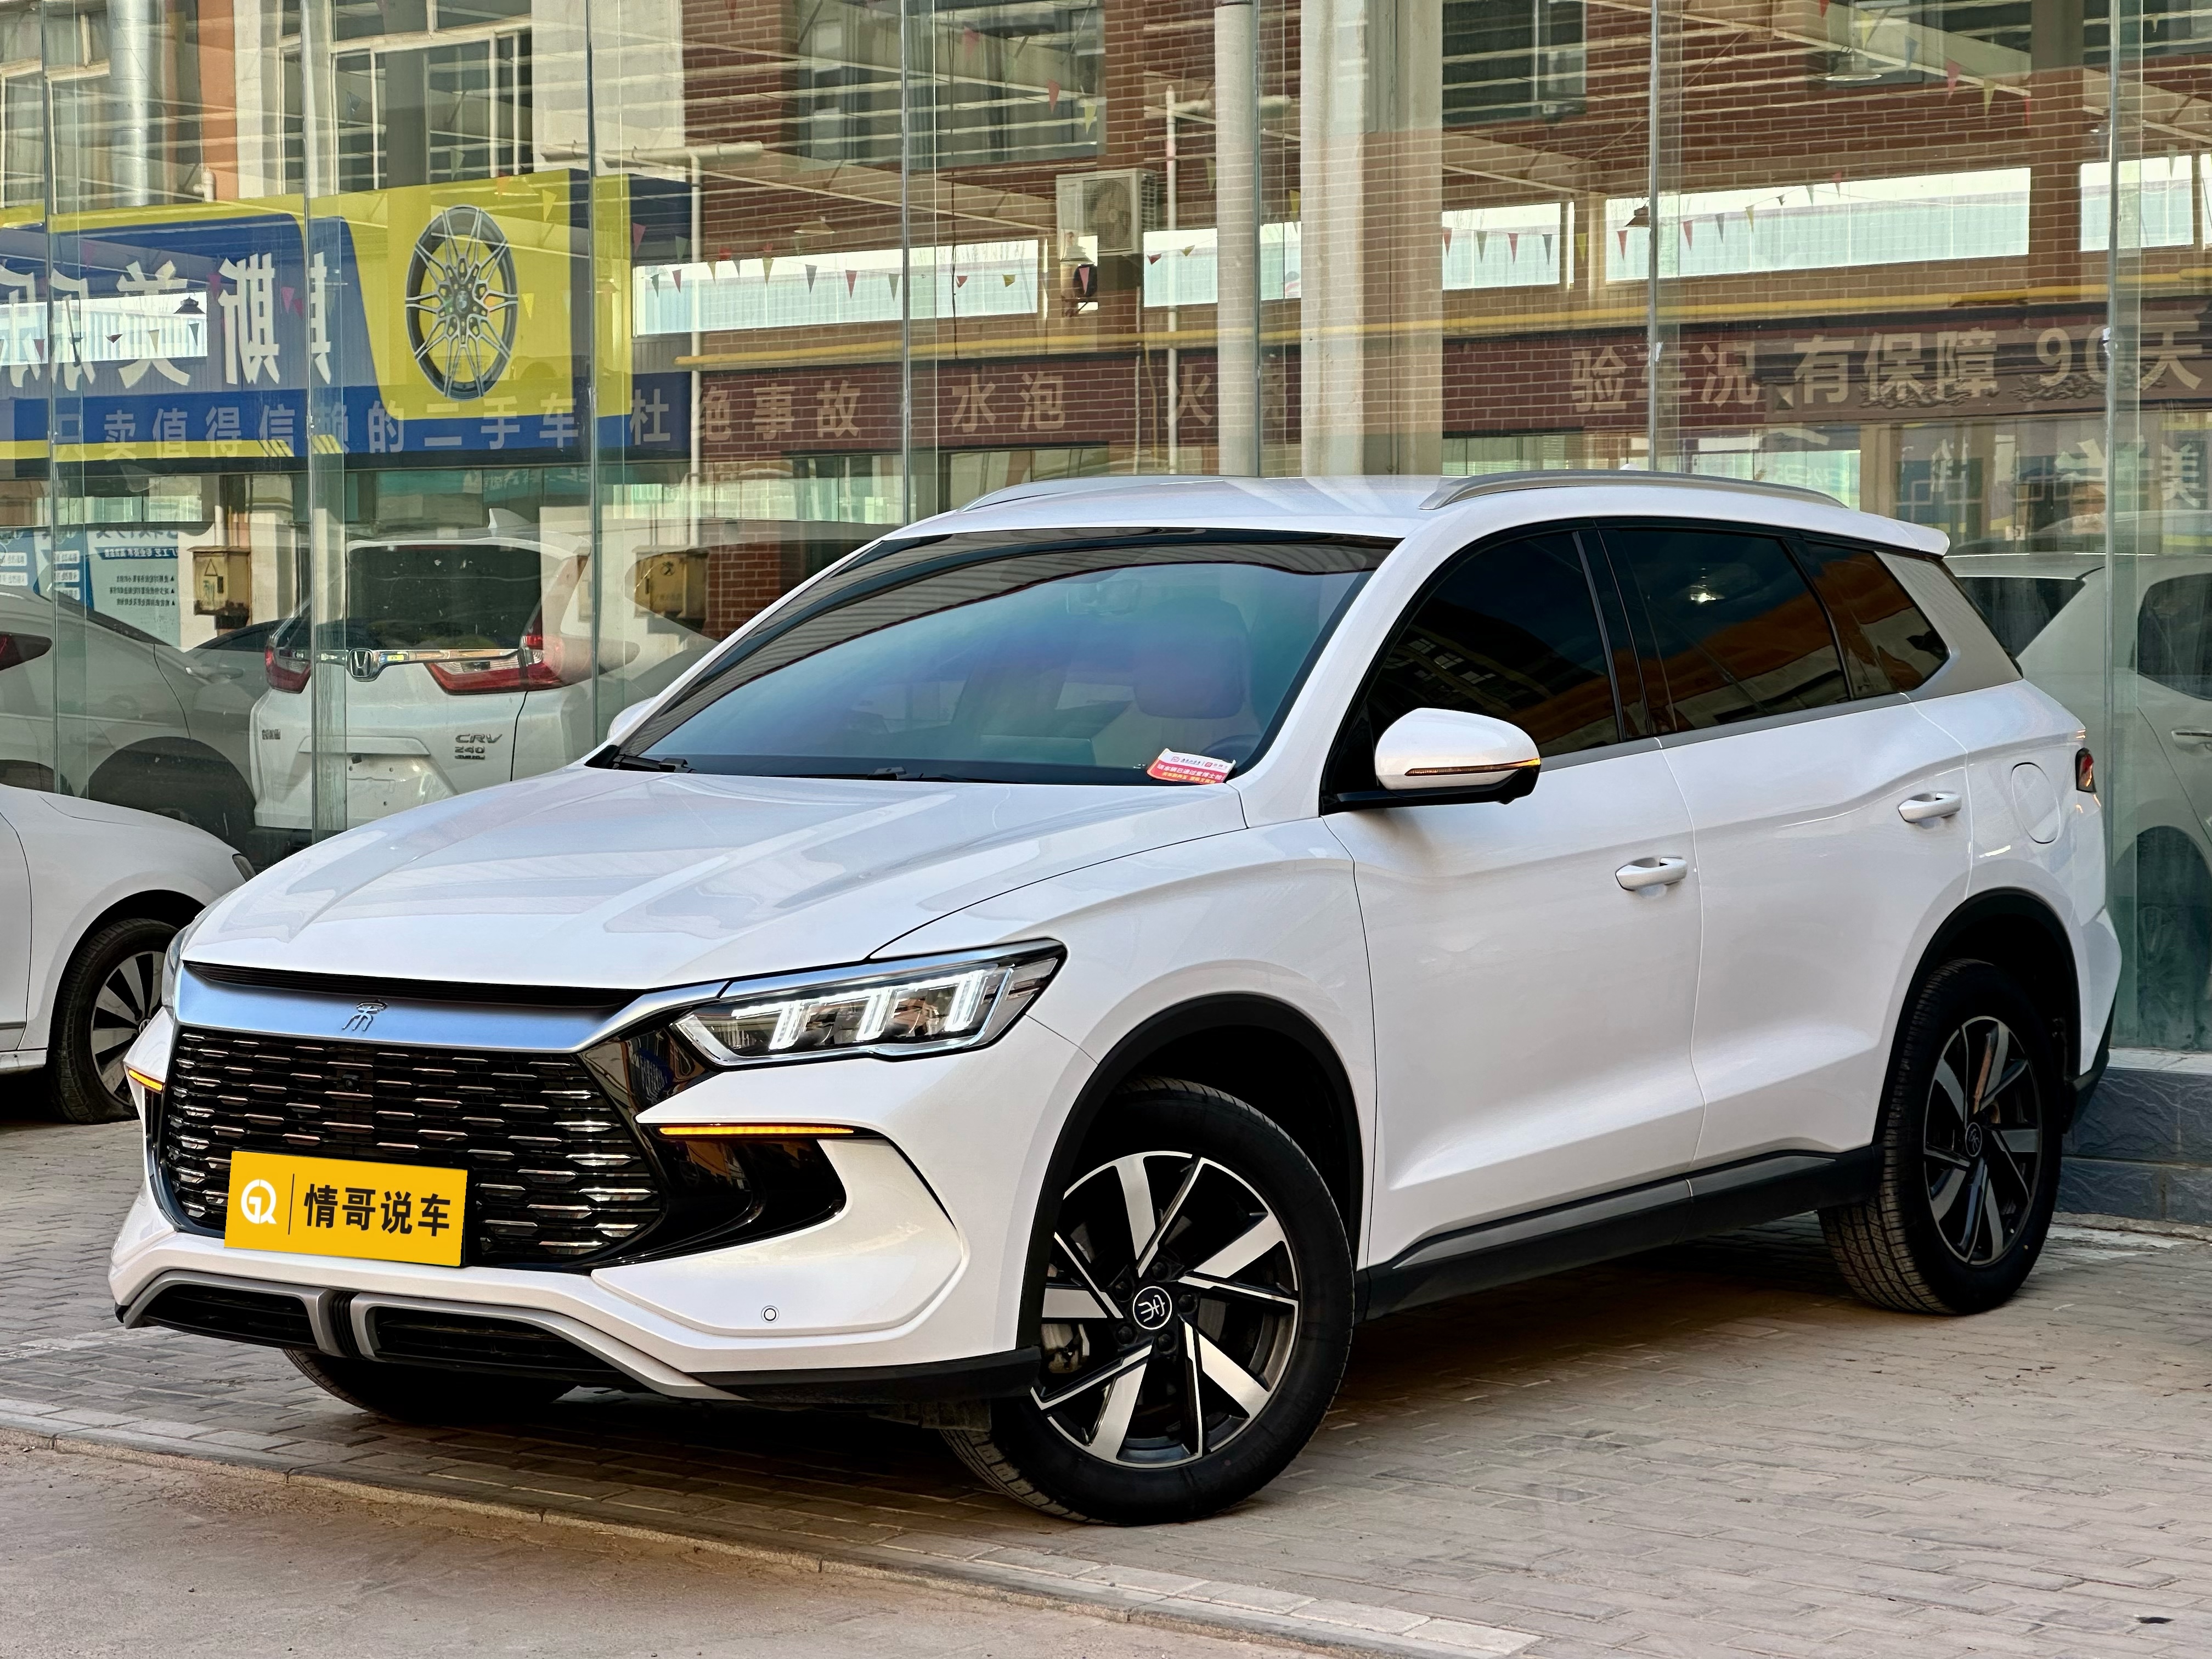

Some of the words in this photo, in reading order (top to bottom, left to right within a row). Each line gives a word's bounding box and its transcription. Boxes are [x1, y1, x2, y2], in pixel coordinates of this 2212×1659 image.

[57, 392, 579, 461] 只卖值得信赖的二手车
[629, 379, 861, 446] 杜绝事故
[951, 371, 1065, 433] 水泡
[1571, 341, 1760, 413] 验车况
[1793, 327, 1999, 403] 有保障
